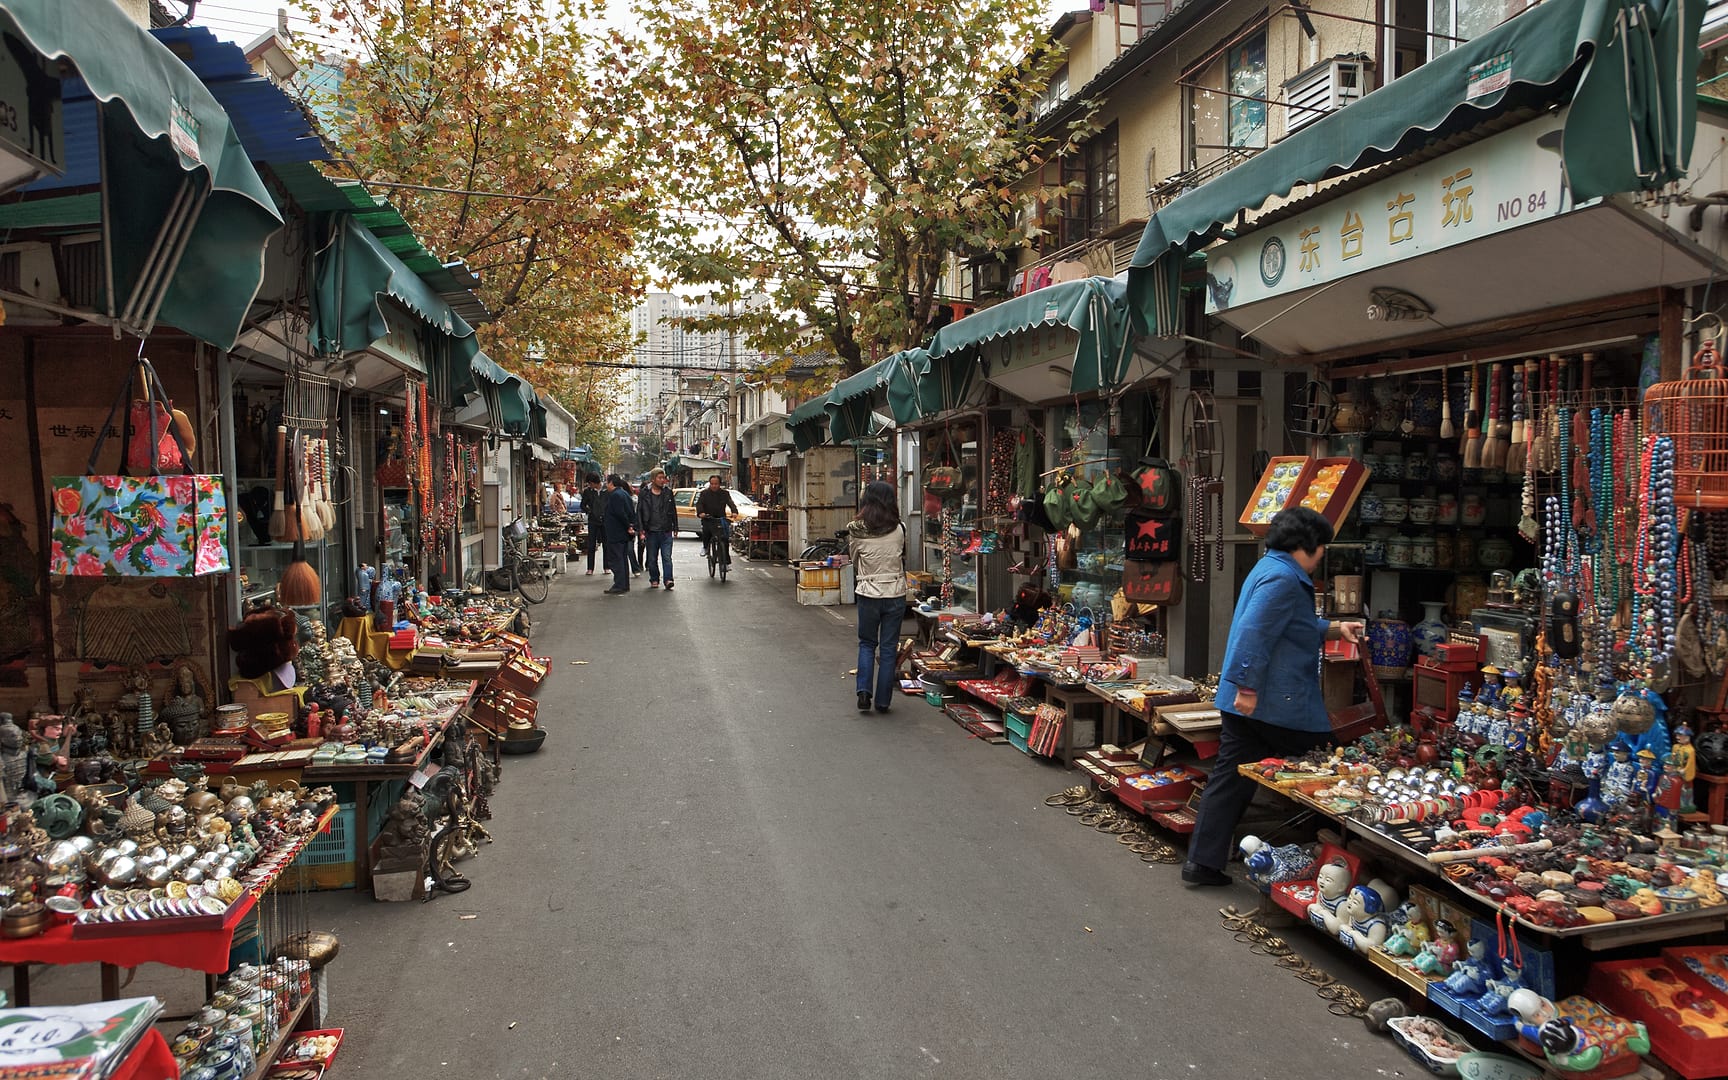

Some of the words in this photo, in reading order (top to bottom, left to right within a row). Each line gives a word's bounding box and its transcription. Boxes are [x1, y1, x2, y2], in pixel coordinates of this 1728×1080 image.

[1299, 167, 1474, 273] 东台古玩
[1497, 197, 1522, 223] NO
[1527, 189, 1547, 213] 84
